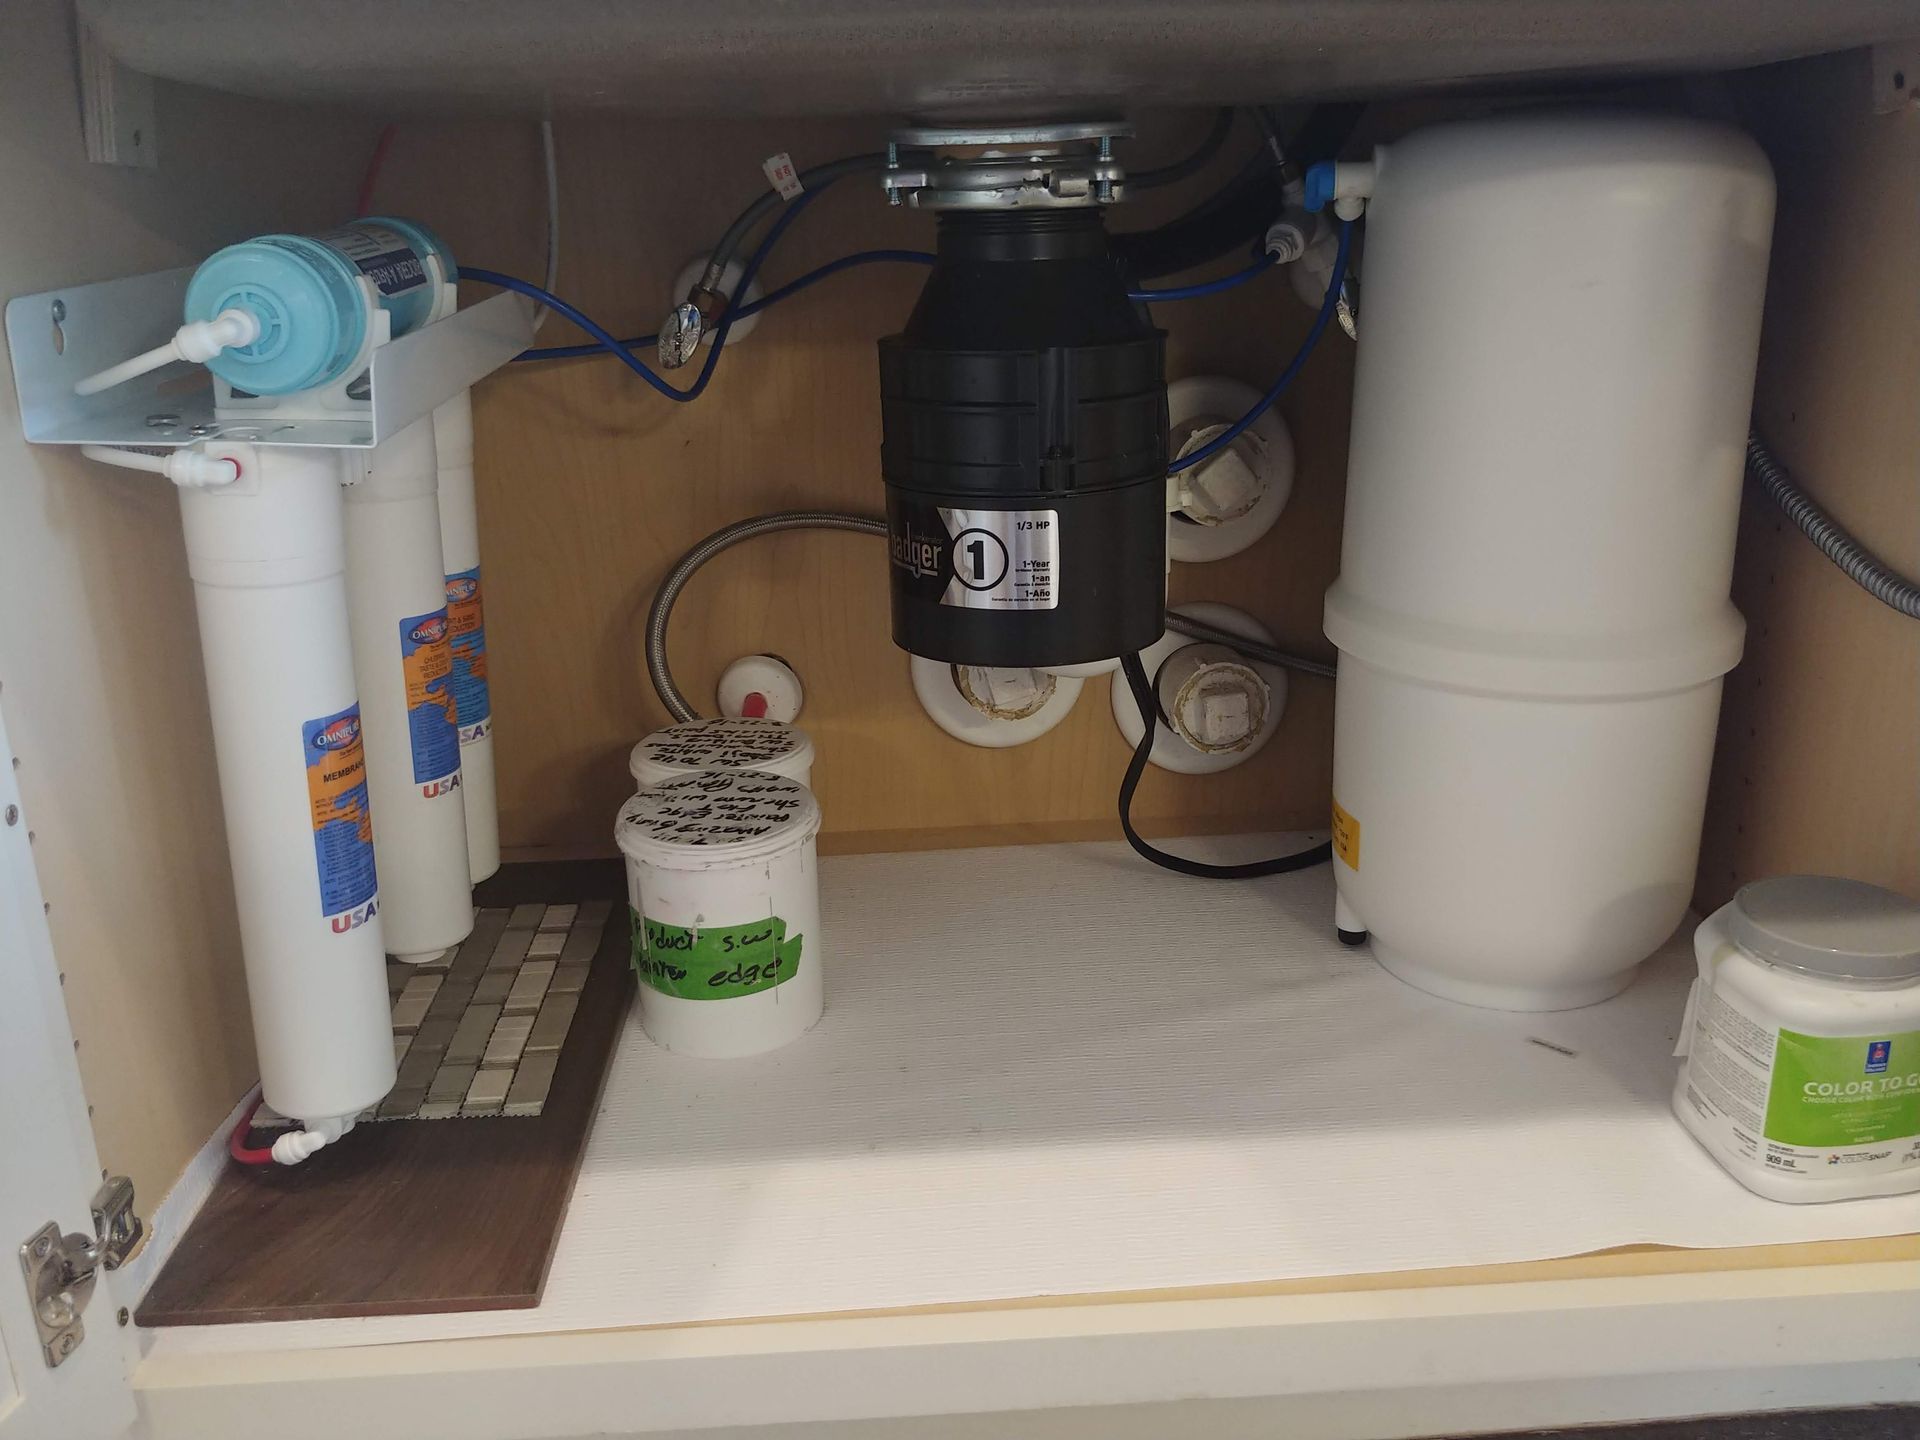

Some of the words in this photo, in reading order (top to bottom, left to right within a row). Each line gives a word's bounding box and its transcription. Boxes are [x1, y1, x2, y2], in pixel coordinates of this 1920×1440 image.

[1016, 521, 1033, 531] 1/3
[1036, 521, 1050, 530] HP
[1022, 560, 1050, 568] 1-Year
[1031, 574, 1050, 582] 1-an
[1025, 588, 1050, 598] 1-Año
[423, 775, 460, 799] USA
[331, 902, 377, 934] USA
[1803, 1080, 1873, 1096] COLOR
[1879, 1076, 1902, 1092] TO
